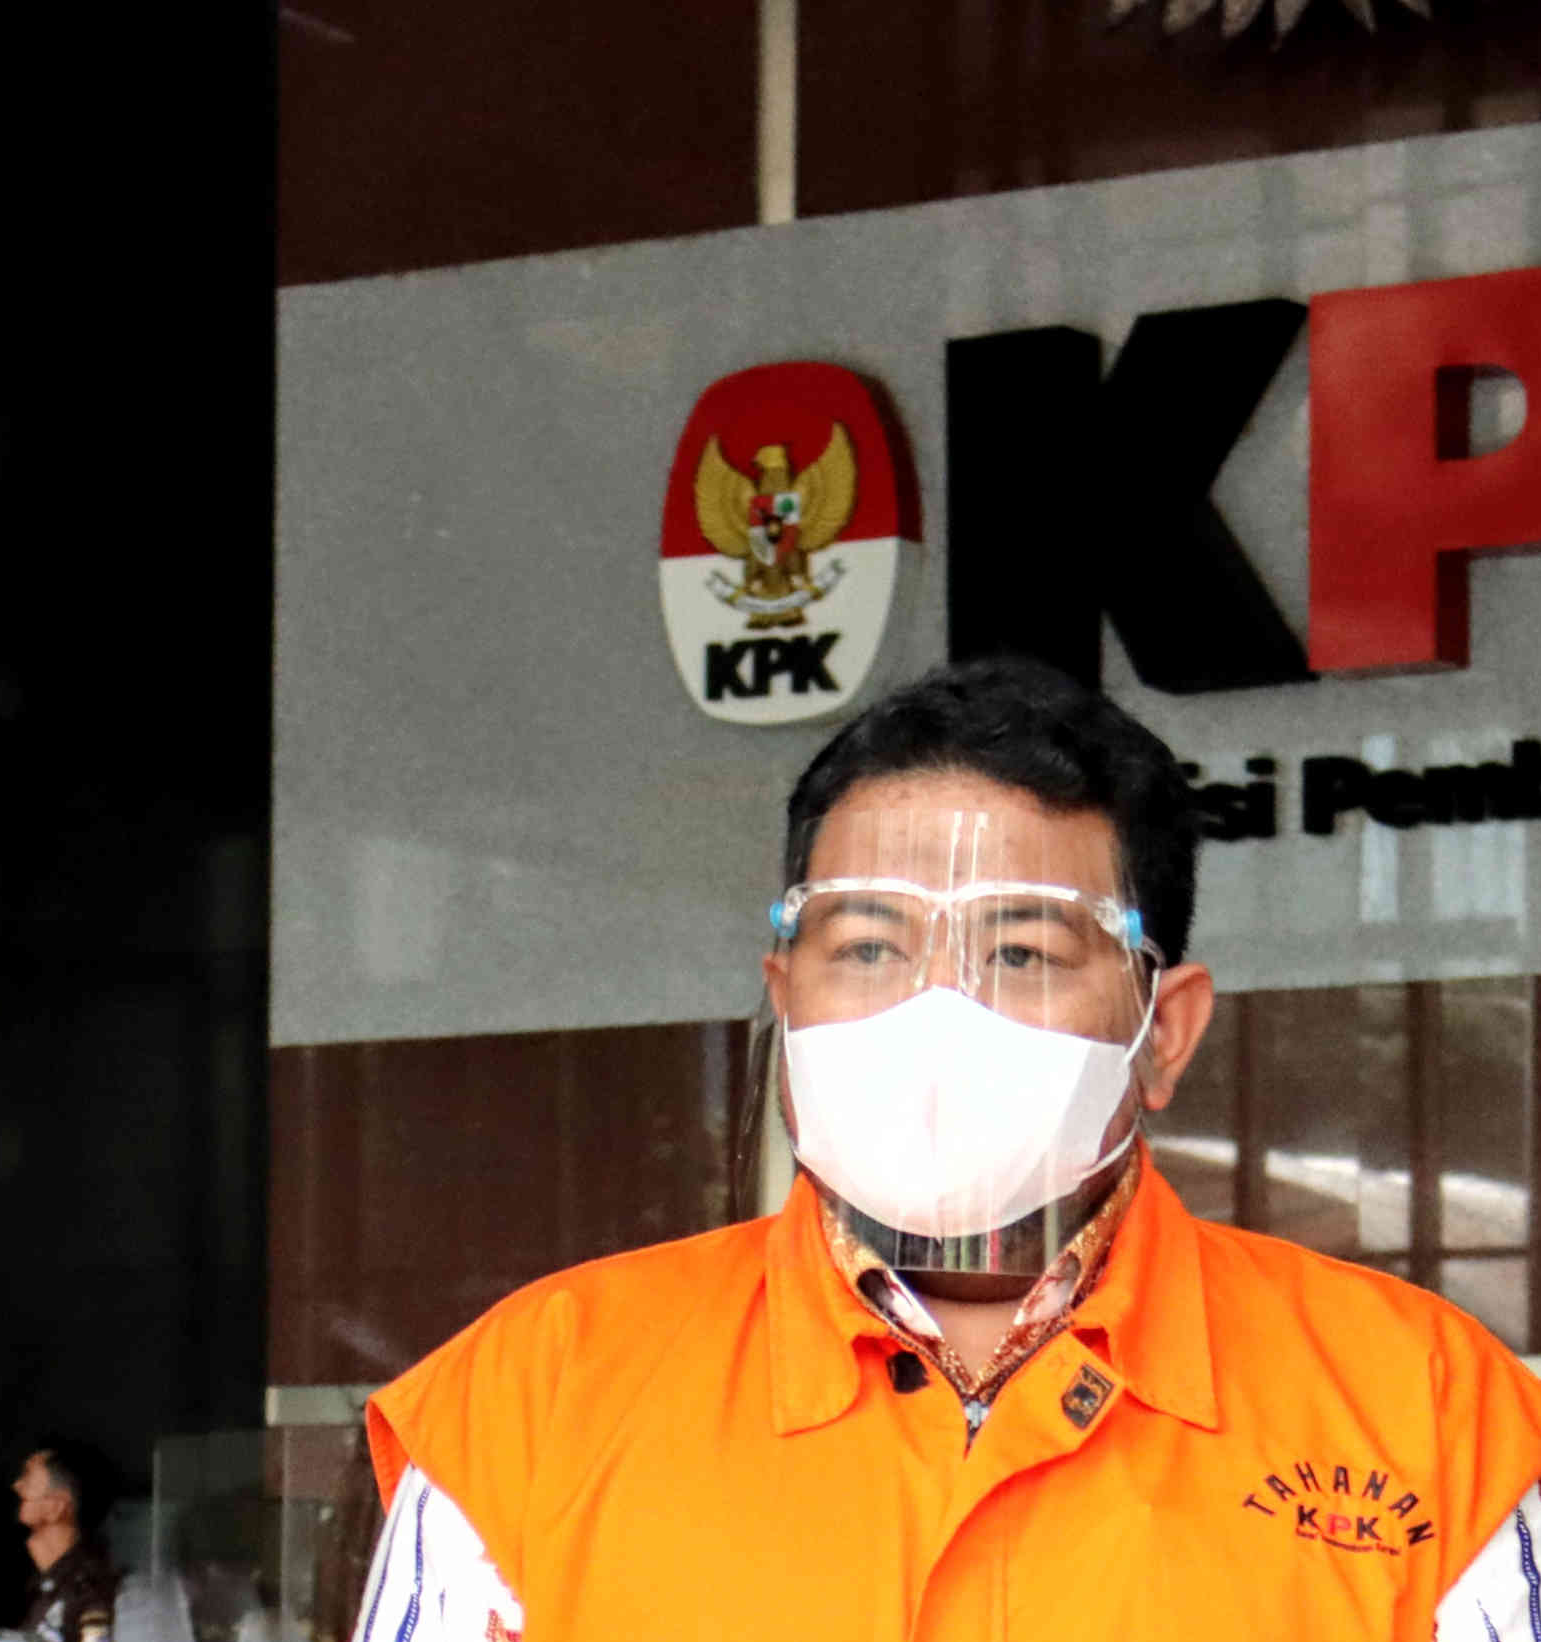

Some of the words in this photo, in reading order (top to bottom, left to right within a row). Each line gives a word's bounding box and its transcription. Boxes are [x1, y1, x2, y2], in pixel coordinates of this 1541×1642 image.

[705, 632, 842, 701] KPK
[1242, 1461, 1437, 1547] TAHANAN
[1296, 1505, 1383, 1542] KPK
